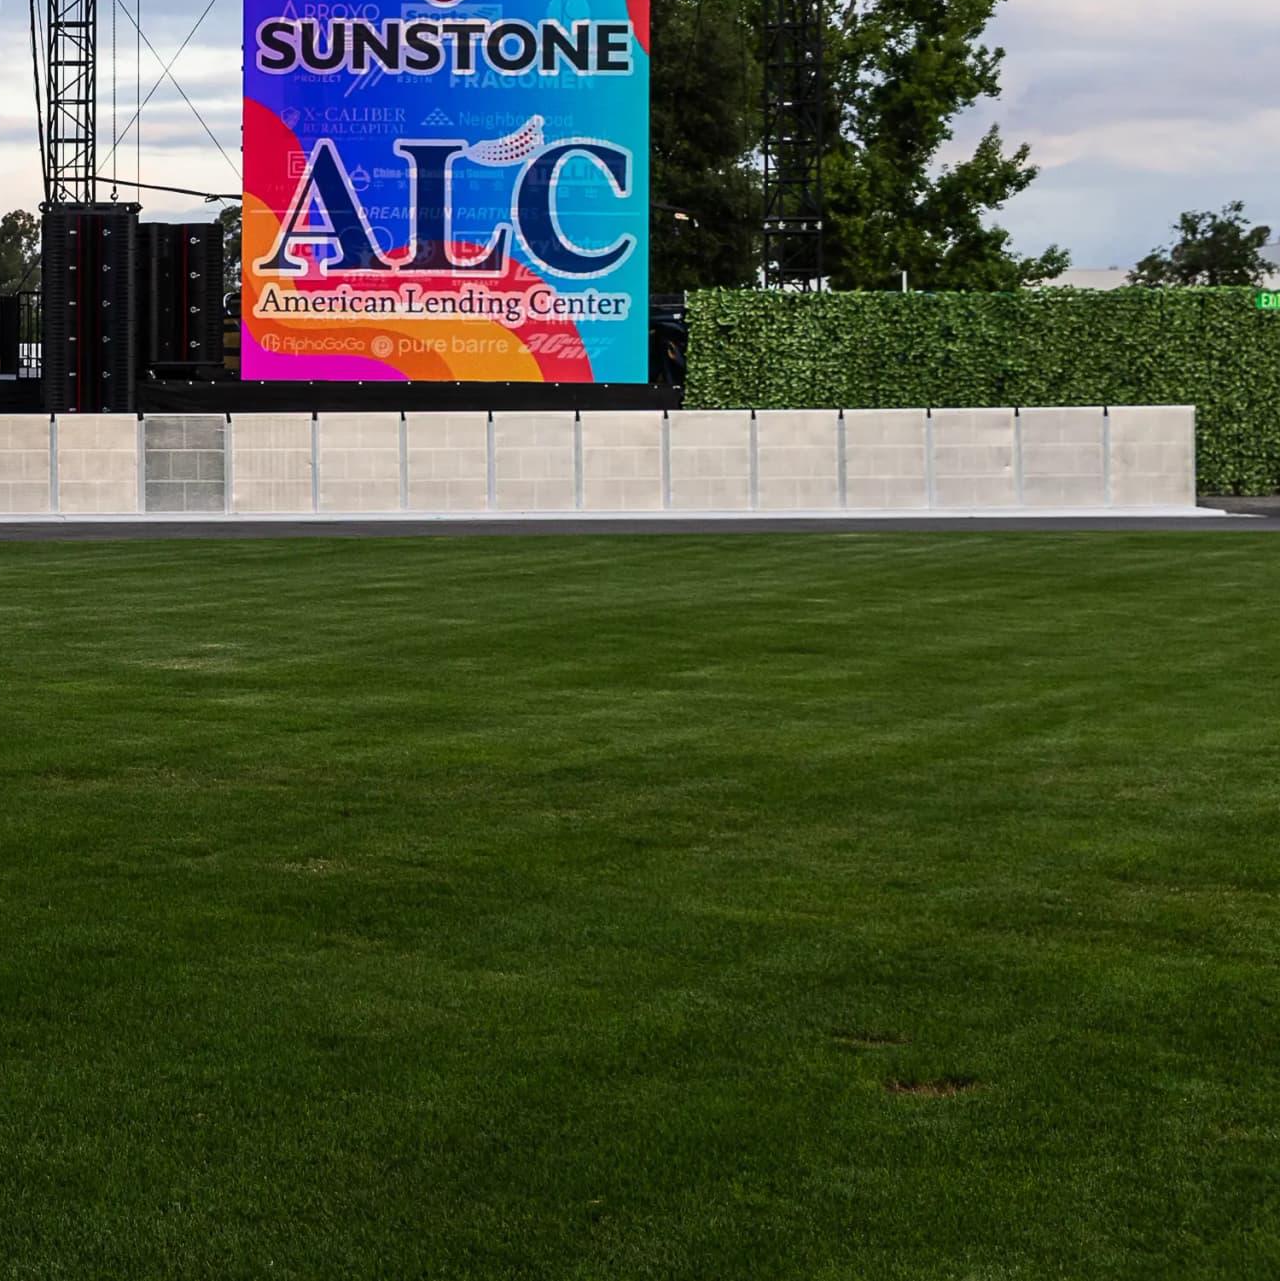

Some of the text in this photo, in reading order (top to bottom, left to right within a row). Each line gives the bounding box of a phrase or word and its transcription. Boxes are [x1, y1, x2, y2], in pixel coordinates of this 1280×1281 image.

[260, 23, 629, 70] SUNSTONE
[449, 71, 594, 88] FRAGOMEN
[303, 107, 407, 121] X-CALIBER
[259, 143, 632, 274] ALC
[358, 206, 415, 220] DREAM
[259, 288, 396, 313] American
[405, 290, 521, 321] Lending
[529, 291, 626, 315] Center
[282, 336, 366, 356] AlphaGoGo
[397, 336, 509, 356] pure barre
